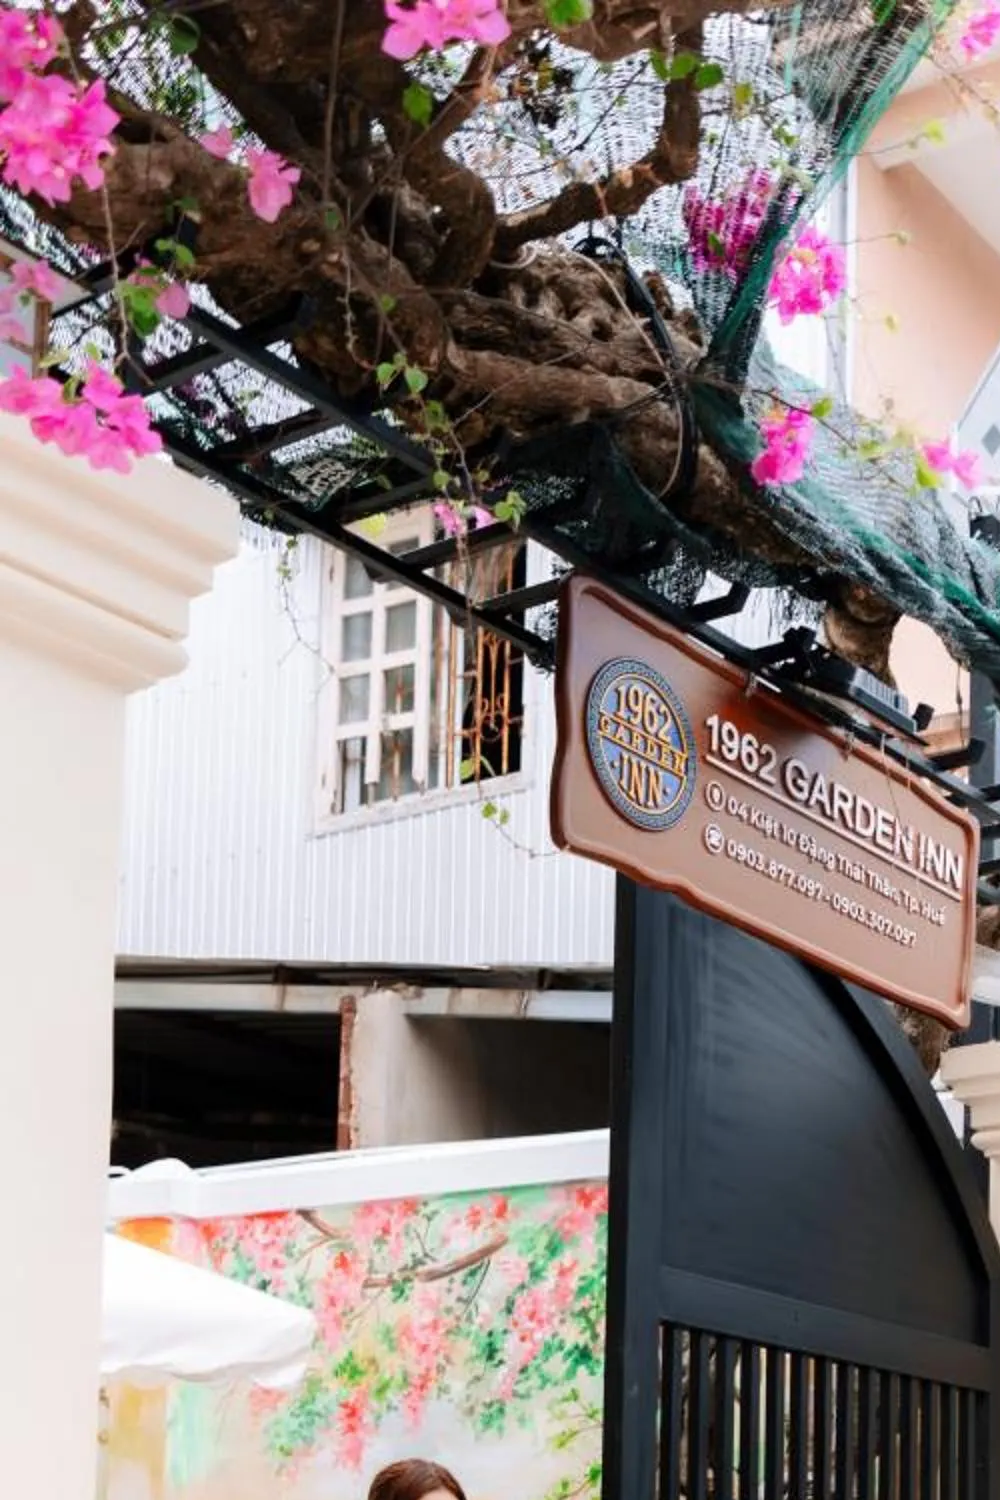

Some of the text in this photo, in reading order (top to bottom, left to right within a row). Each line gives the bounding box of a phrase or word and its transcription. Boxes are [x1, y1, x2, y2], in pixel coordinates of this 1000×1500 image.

[615, 685, 672, 742] 1962
[601, 716, 689, 775] GARDEN
[619, 754, 664, 808] INN
[706, 714, 963, 889] 1962 GARDEN INN
[727, 795, 748, 820] 04
